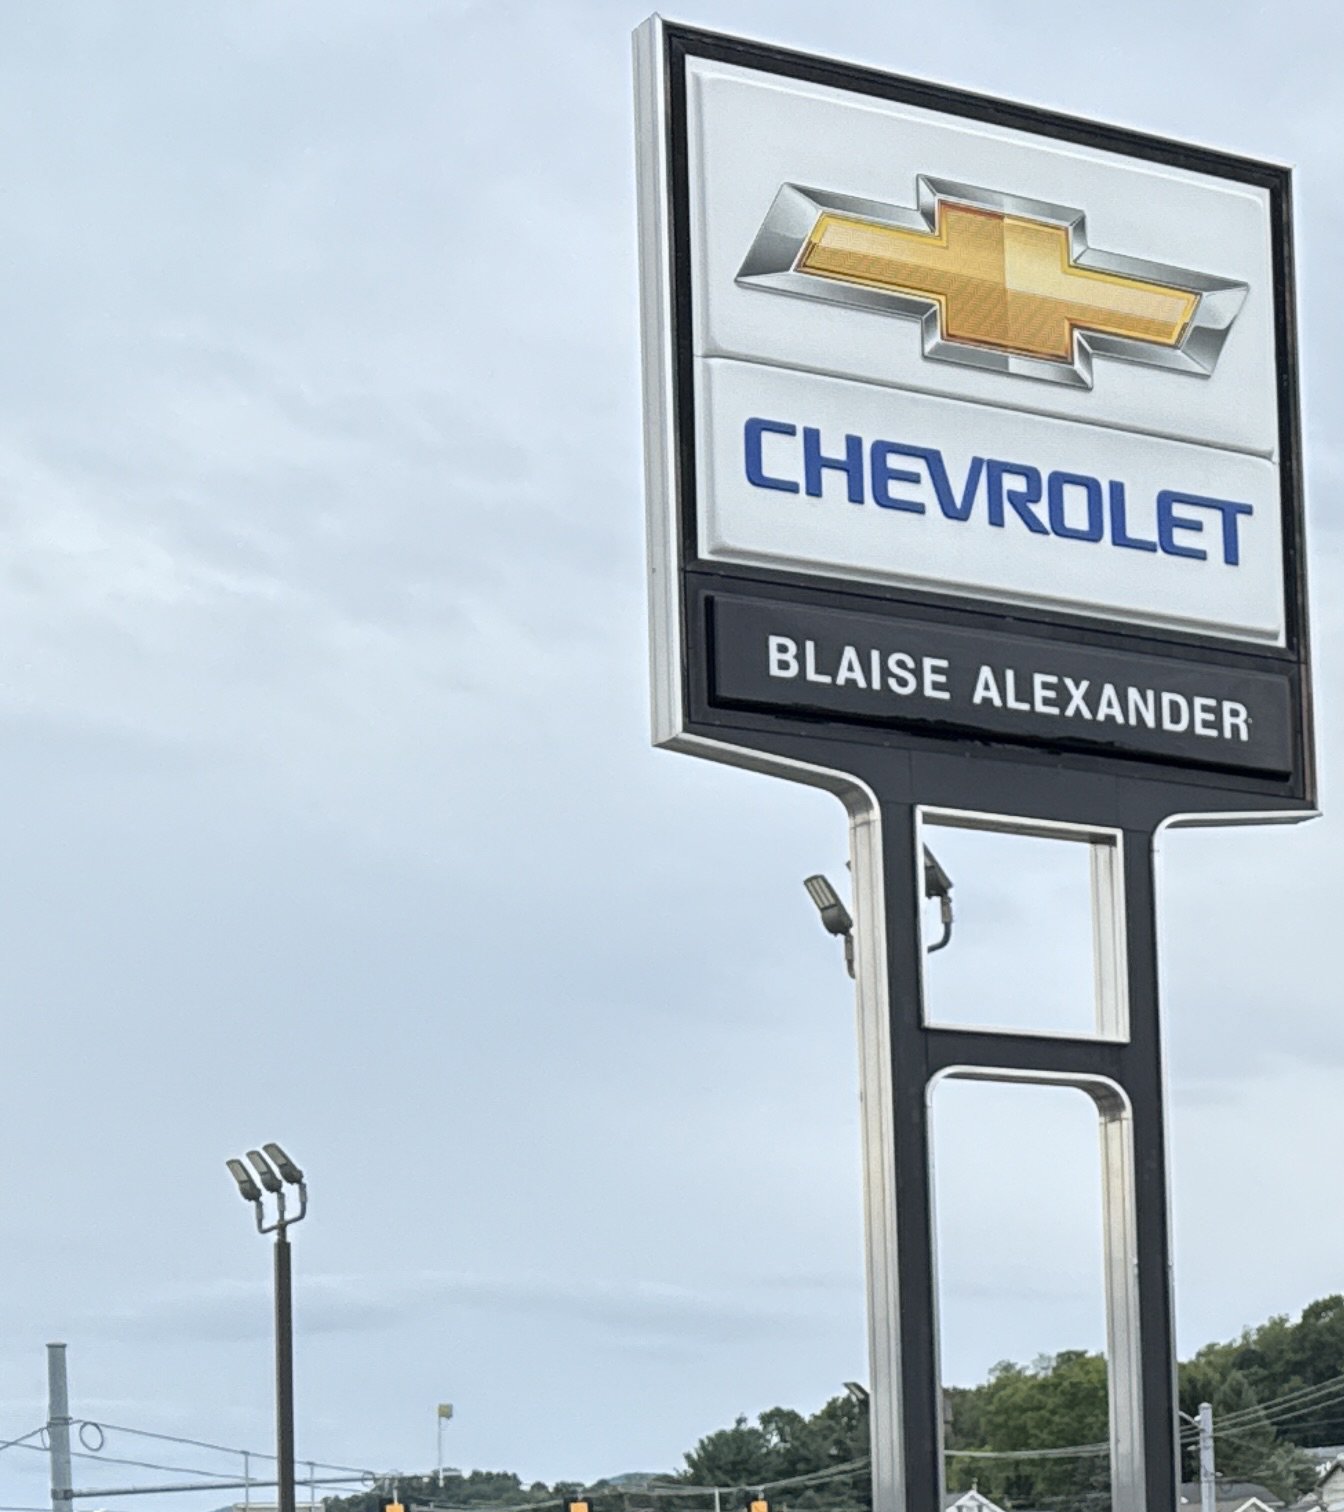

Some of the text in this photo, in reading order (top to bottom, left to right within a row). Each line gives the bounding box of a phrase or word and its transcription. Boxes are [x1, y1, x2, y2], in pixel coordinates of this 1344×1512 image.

[744, 417, 1253, 567] CHEVROLET
[767, 635, 1249, 742] BLAISE ALEXANDER
